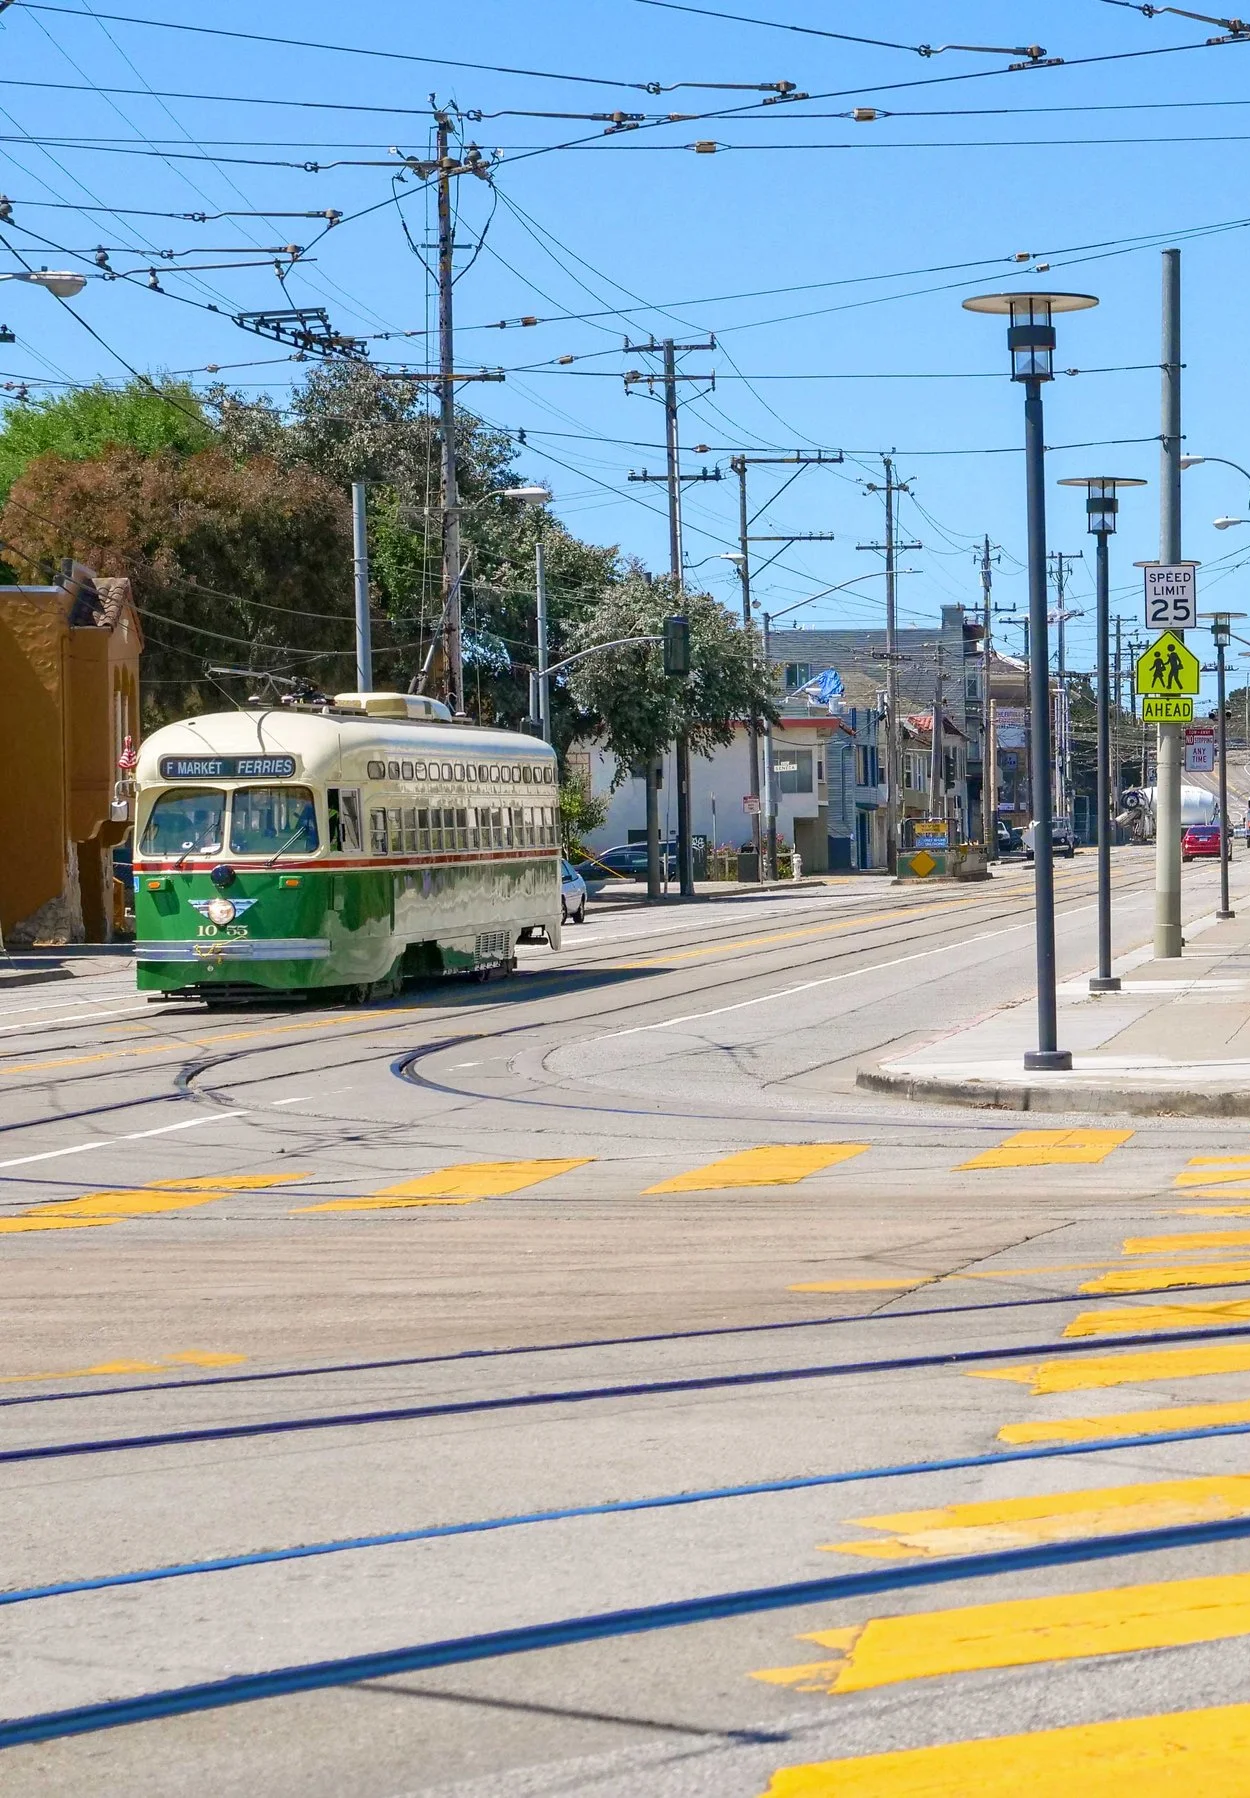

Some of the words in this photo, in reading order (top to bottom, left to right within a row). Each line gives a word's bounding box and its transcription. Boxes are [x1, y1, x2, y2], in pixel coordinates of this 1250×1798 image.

[1149, 572, 1191, 583] SPEED
[1153, 585, 1187, 596] LIMIT
[1150, 598, 1191, 622] 25
[1145, 702, 1191, 717] AHEAD
[1185, 735, 1194, 744] NO
[1194, 736, 1213, 744] STOPPING
[1192, 747, 1206, 755] ANY
[1192, 755, 1208, 763] TIME
[166, 762, 174, 775] F
[177, 761, 222, 775] MARKET
[237, 760, 293, 774] FERRIES
[196, 925, 218, 937] 10
[226, 924, 249, 936] 55
